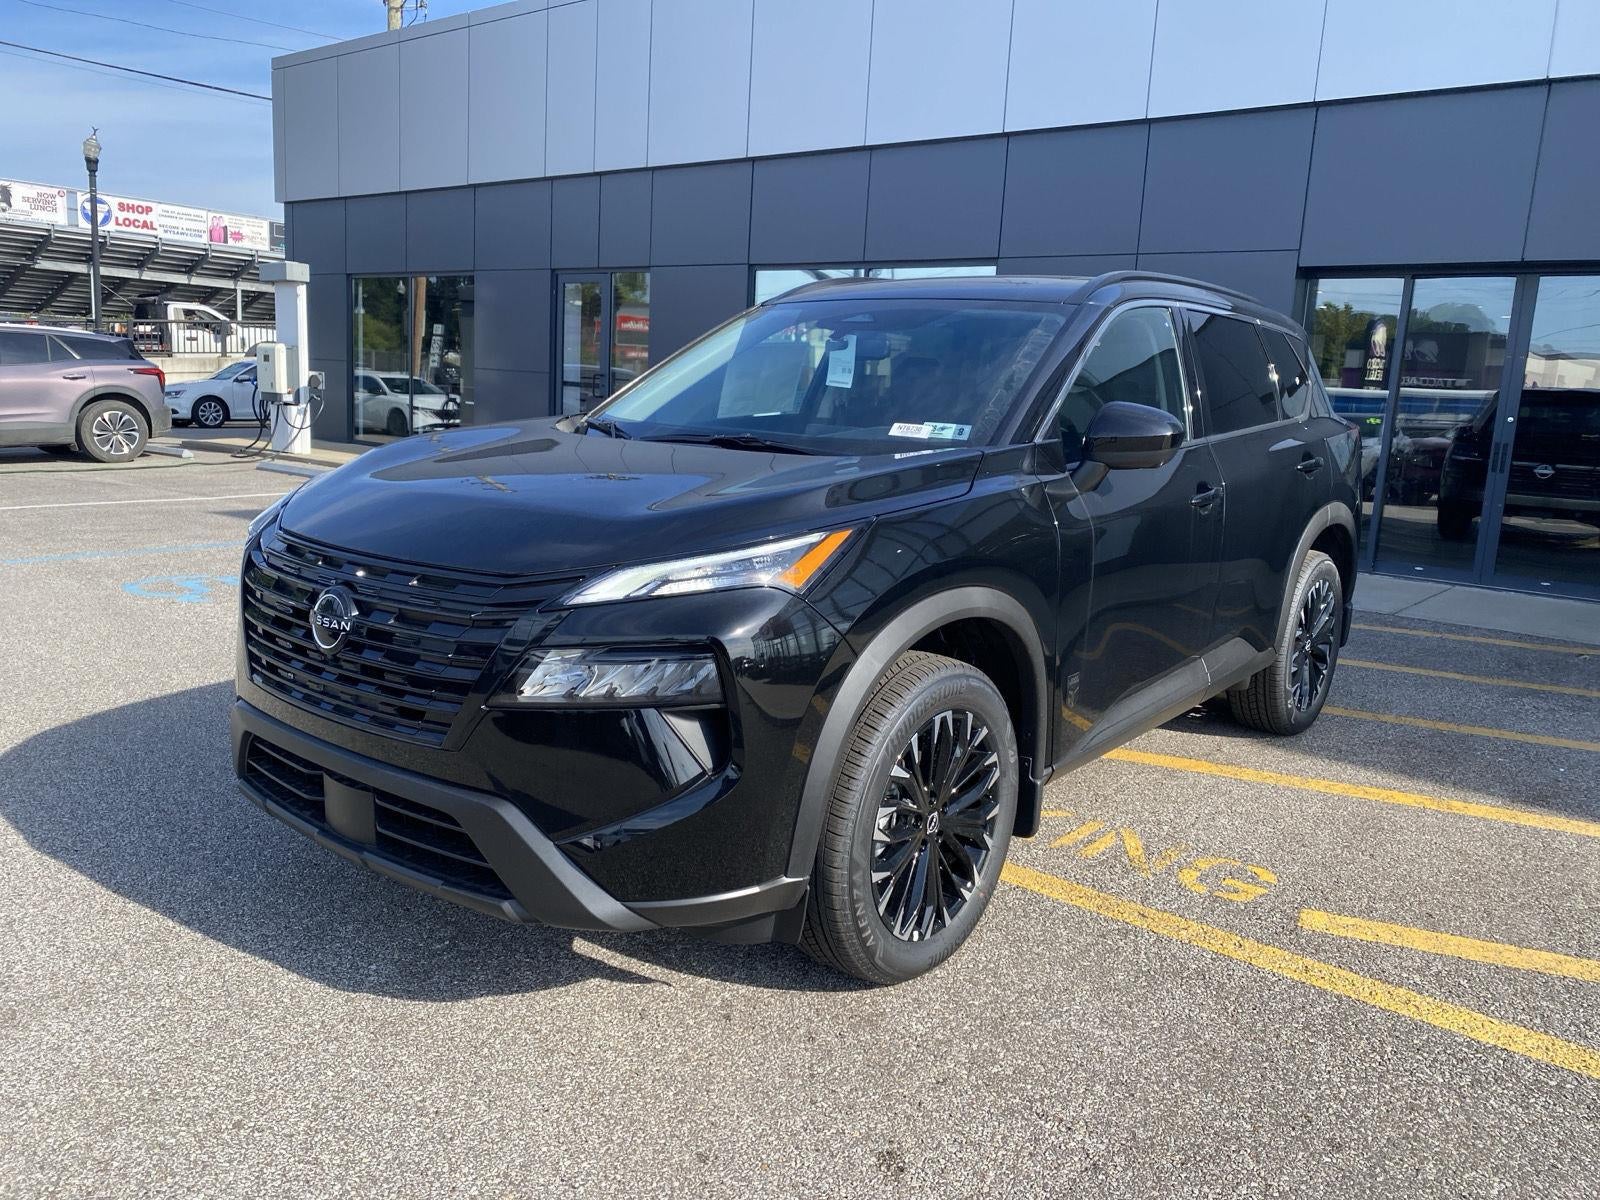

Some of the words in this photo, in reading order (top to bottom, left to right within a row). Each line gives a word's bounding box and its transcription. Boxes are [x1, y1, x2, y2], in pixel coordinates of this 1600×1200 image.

[21, 195, 57, 207] SERVING
[36, 191, 57, 200] NOW
[29, 203, 58, 213] LUNCH
[117, 202, 153, 216] SHOP
[114, 216, 158, 231] LOCAL
[315, 614, 351, 632] SSAN
